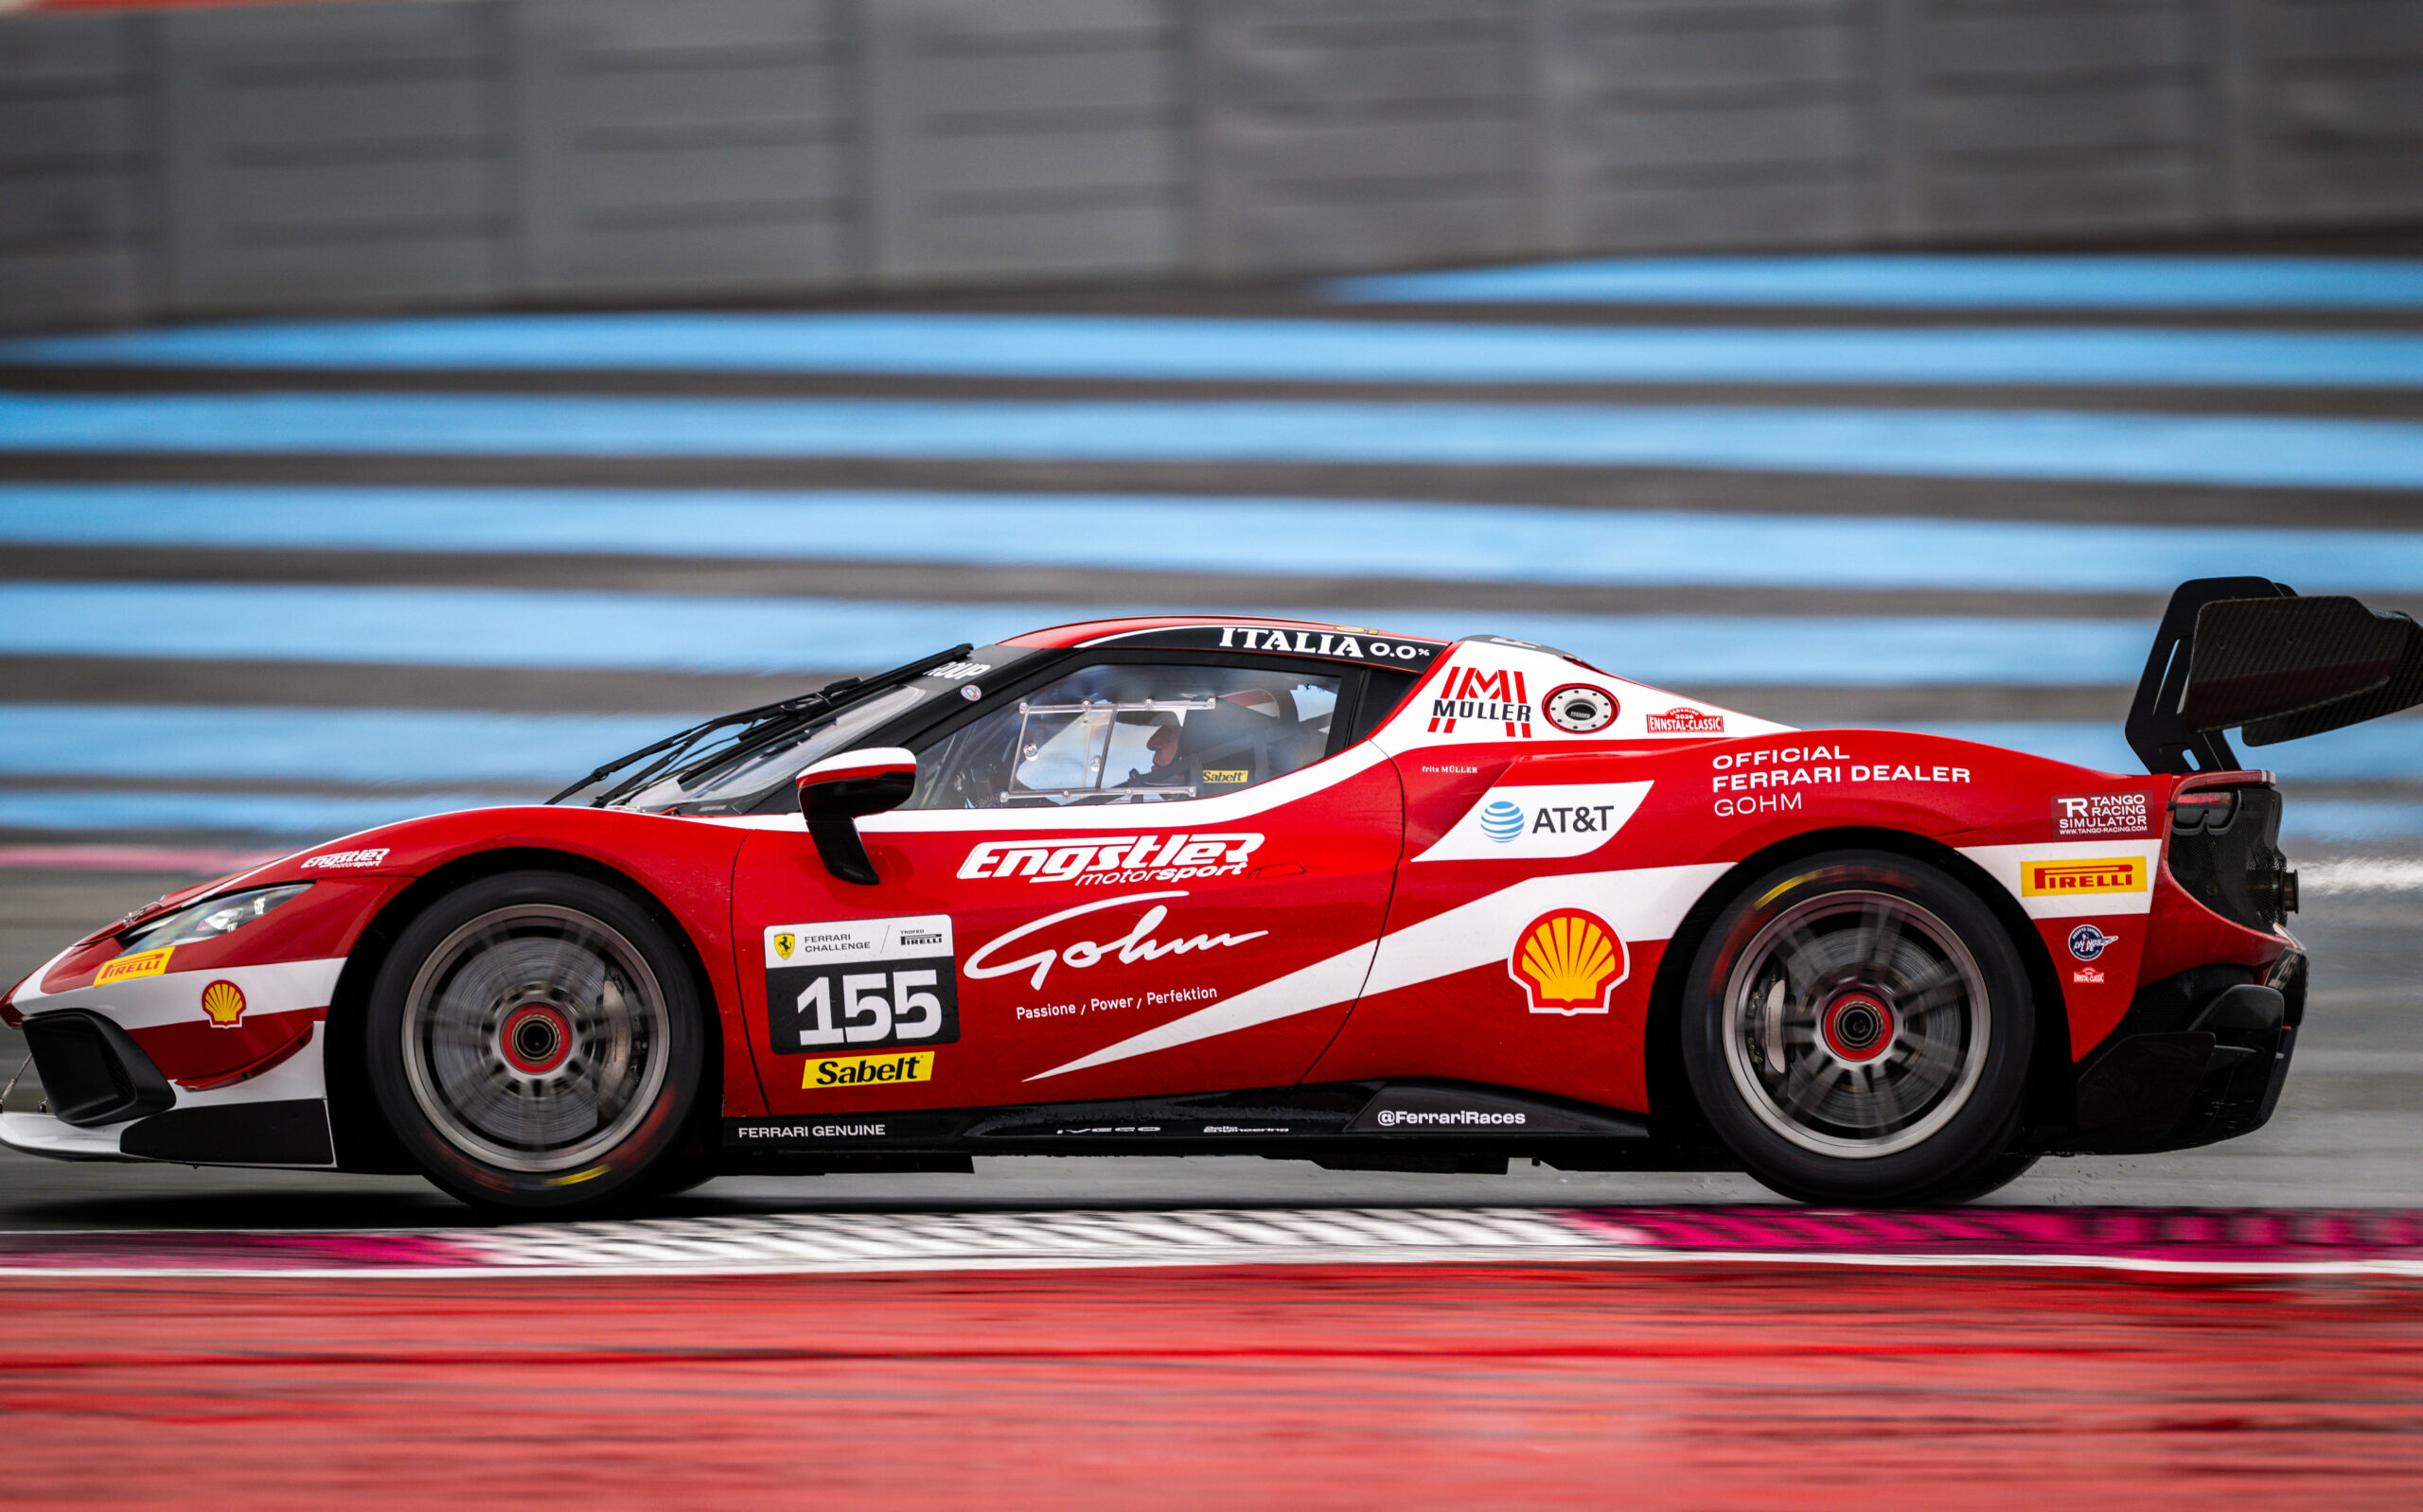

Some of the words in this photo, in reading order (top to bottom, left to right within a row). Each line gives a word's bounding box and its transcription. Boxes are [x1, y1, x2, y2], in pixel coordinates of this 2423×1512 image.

[1219, 627, 1364, 658] ITALIA
[1432, 699, 1531, 722] MÜLLER
[1649, 716, 1722, 731] ENNSTAL-CLASSIC
[1712, 746, 1850, 769] OFFICIAL
[1203, 771, 1243, 782] Sabelt
[1441, 765, 1477, 774] MÜLLER
[1712, 766, 1841, 793] FERRARI
[1851, 765, 1971, 783] DEALER
[1714, 792, 1802, 817] GOHM
[2090, 794, 2146, 806] TANGO
[2091, 804, 2147, 817] RACING
[1531, 805, 1615, 835] AT&T
[2059, 816, 2147, 829] SIMULATOR
[2060, 825, 2148, 835] WWW.TANGO-RACING.COM
[1074, 862, 1247, 886] motorsport
[2034, 864, 2133, 889] PIRELLI
[805, 934, 851, 943] FERRARI
[805, 941, 871, 953] CHALLENGE
[900, 934, 942, 945] PIRELLI
[963, 889, 1269, 991] Gohm
[100, 953, 165, 979] PIRELLI
[797, 969, 943, 1046] 155
[1016, 1004, 1076, 1020] Passione
[1090, 996, 1134, 1012] Power
[1147, 987, 1218, 1006] Perfektion
[816, 1056, 921, 1085] Sabelt
[1377, 1110, 1526, 1127] @FerrariRaces
[738, 1126, 809, 1138] FERRARI
[812, 1124, 886, 1136] GENUINE
